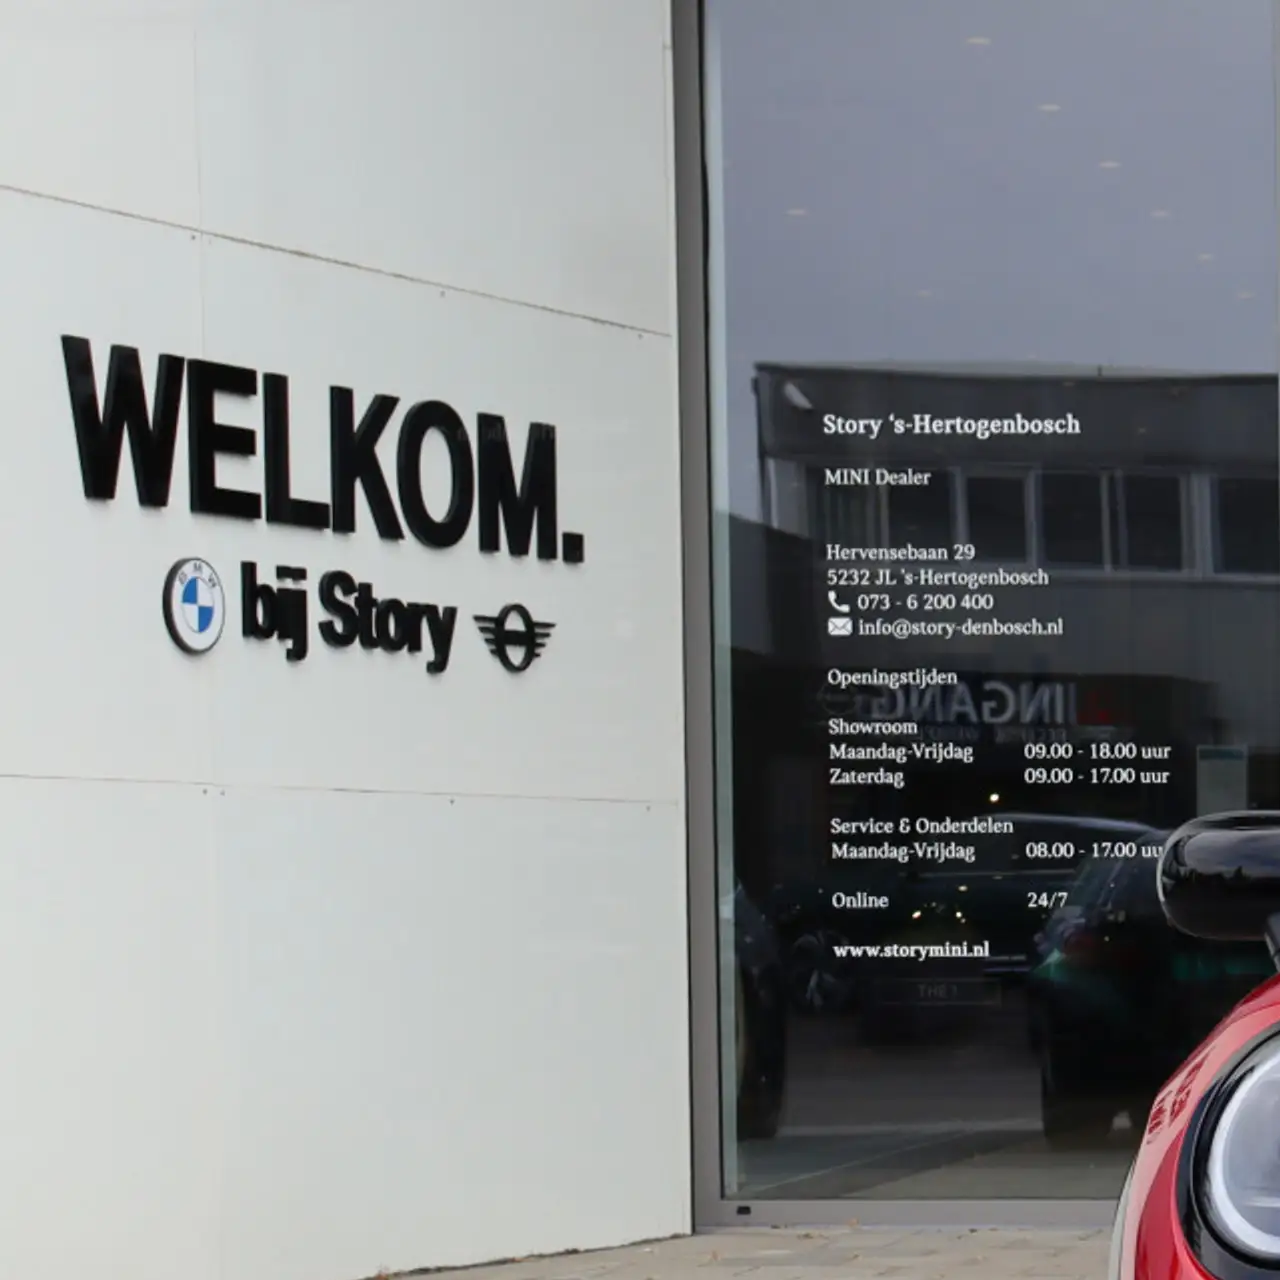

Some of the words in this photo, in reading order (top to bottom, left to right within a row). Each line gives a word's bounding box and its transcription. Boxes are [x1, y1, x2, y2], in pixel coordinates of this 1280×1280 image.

[824, 415, 882, 439] Story
[61, 335, 585, 562] WELKOM.
[826, 469, 868, 484] MINI
[876, 468, 931, 485] Dealer
[827, 544, 947, 560] Hervensebaan
[954, 544, 975, 560] 29
[828, 569, 869, 585] 5232
[876, 569, 896, 585] JL
[858, 594, 890, 609] 073
[907, 594, 917, 609] 6
[924, 594, 955, 609] 200
[961, 595, 993, 609] 400
[241, 562, 307, 662] bij
[319, 571, 457, 674] Story
[860, 618, 1062, 639] info@story-denbosch.nl
[828, 669, 957, 689] Openingstijden
[829, 719, 917, 734] Showroom
[830, 743, 973, 763] Maandag-Vrijdag
[1025, 743, 1072, 758] 09.00
[1092, 743, 1136, 758] 18.00
[1142, 747, 1171, 758] uur
[830, 768, 904, 788] Zaterdag
[1025, 768, 1073, 783] 09.00
[1092, 768, 1135, 783] 17.00
[1140, 772, 1169, 783] uur
[831, 818, 893, 833] Service
[899, 818, 910, 833] &
[916, 817, 1013, 833] Onderdelen
[832, 842, 975, 863] Maandag-Vrijdag
[1026, 843, 1074, 857] 08.00
[1093, 842, 1136, 857] 17.00
[1141, 845, 1164, 858] uu
[832, 892, 888, 907] Online
[1028, 892, 1068, 907] 24/7
[834, 941, 989, 961] www.storymini.nl
